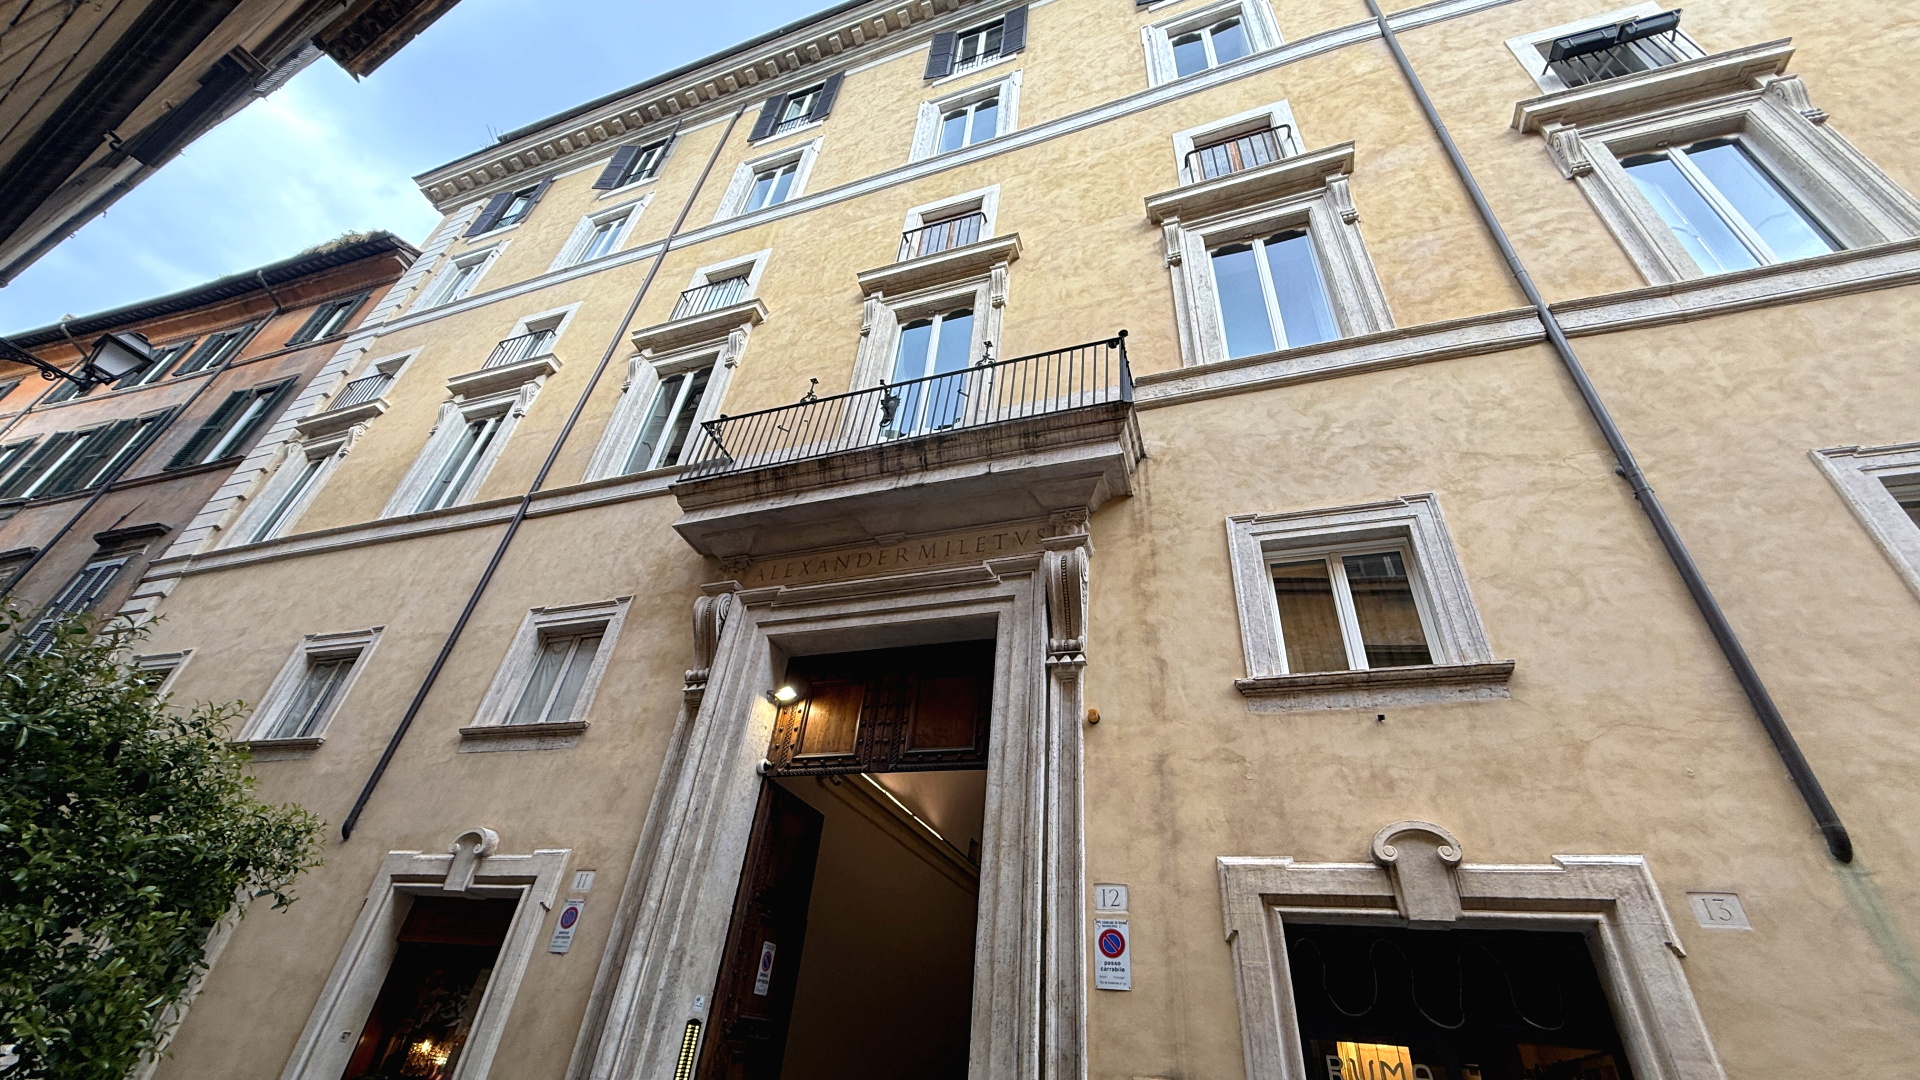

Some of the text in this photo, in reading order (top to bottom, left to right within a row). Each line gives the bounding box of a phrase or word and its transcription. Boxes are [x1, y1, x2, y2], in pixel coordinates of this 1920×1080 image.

[753, 547, 909, 582] ALEXANDER
[1101, 888, 1121, 908] 12
[1701, 898, 1733, 922] 13
